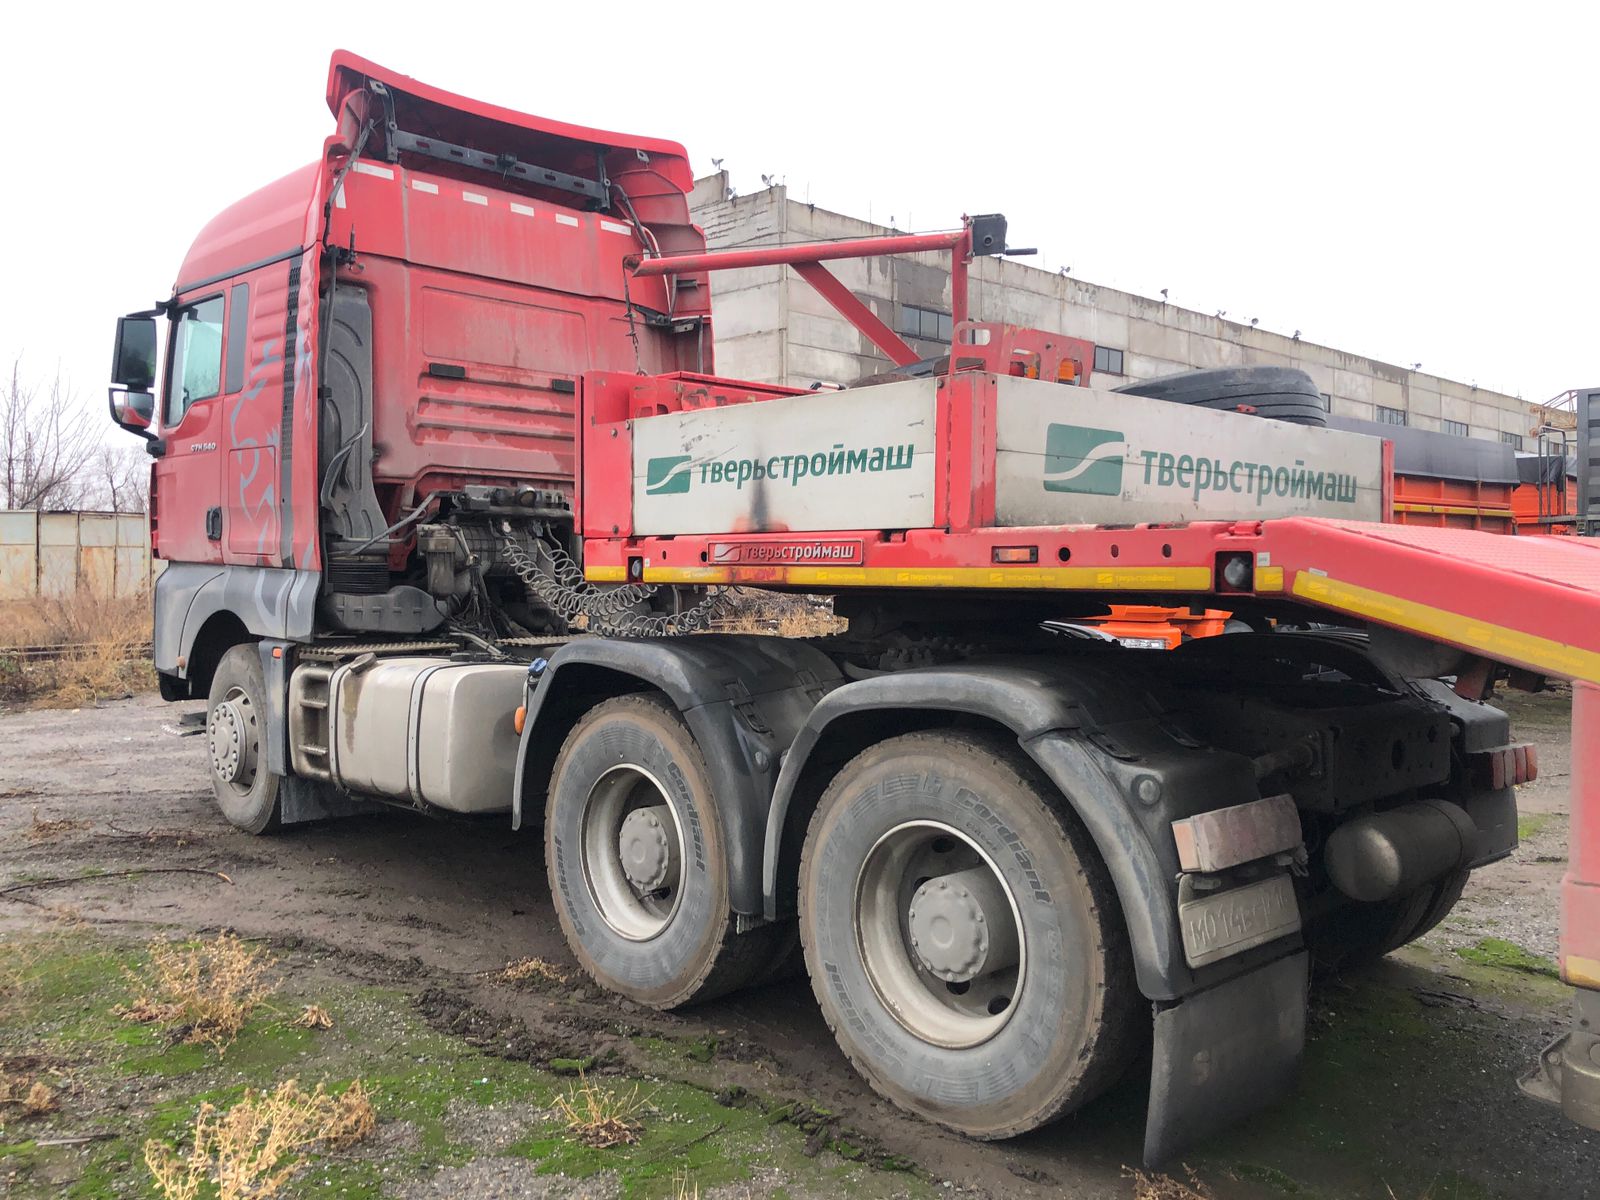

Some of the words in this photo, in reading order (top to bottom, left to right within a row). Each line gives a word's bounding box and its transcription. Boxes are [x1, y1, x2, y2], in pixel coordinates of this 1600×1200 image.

[700, 443, 914, 489] тверьстроймаш
[1140, 449, 1357, 506] тверьстроймаш
[745, 542, 855, 561] тверьстроймаш
[668, 760, 706, 872] Cordiant
[955, 788, 1055, 904] Cordiant
